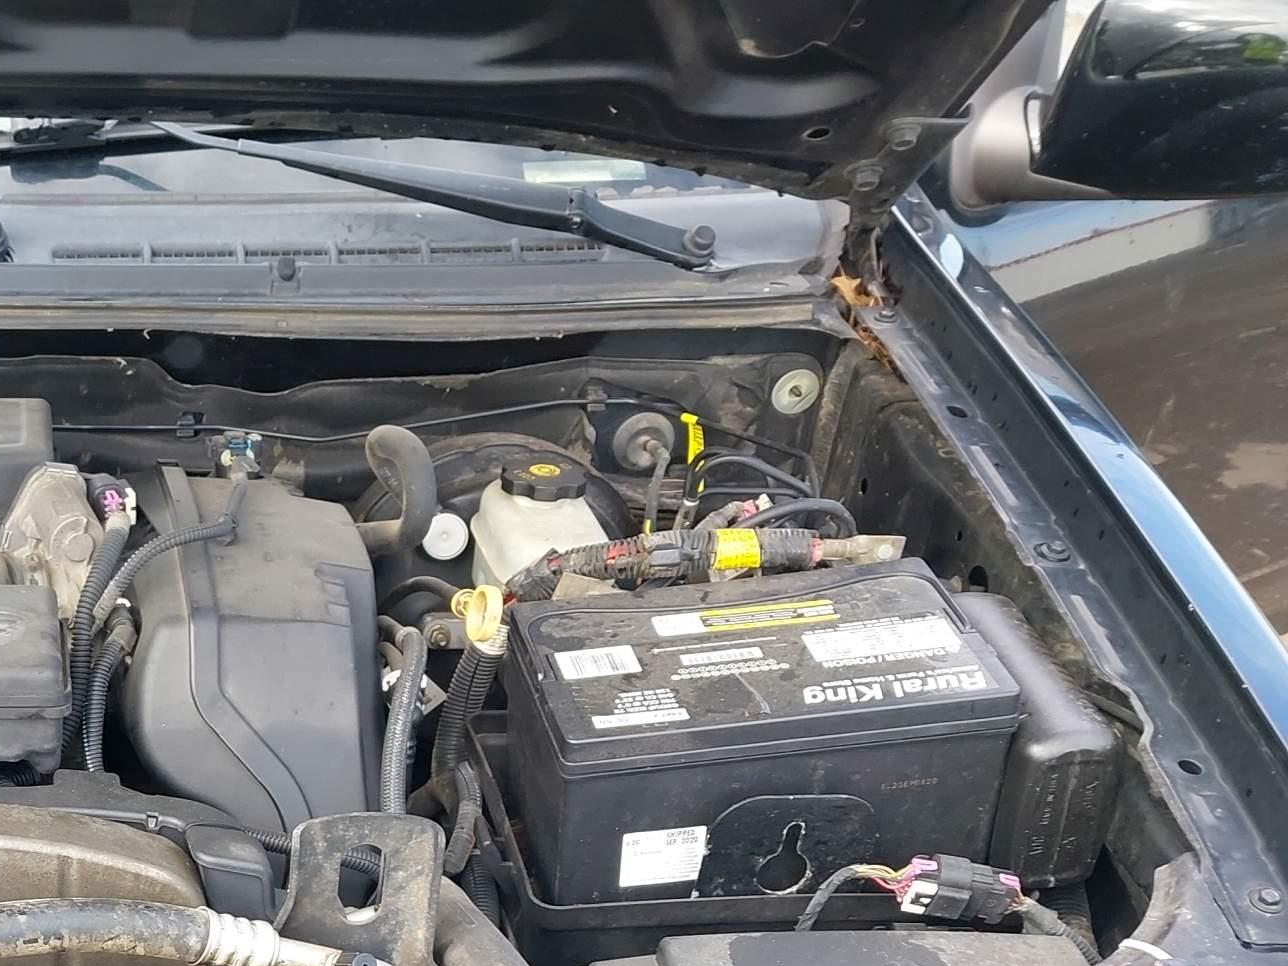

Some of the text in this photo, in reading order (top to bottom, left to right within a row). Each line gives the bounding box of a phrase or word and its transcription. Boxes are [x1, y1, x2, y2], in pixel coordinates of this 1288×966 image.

[821, 654, 878, 668] POISON
[883, 647, 946, 662] DANGER
[852, 674, 884, 684] Home
[896, 671, 925, 680] Farm
[802, 670, 987, 705] Rural King
